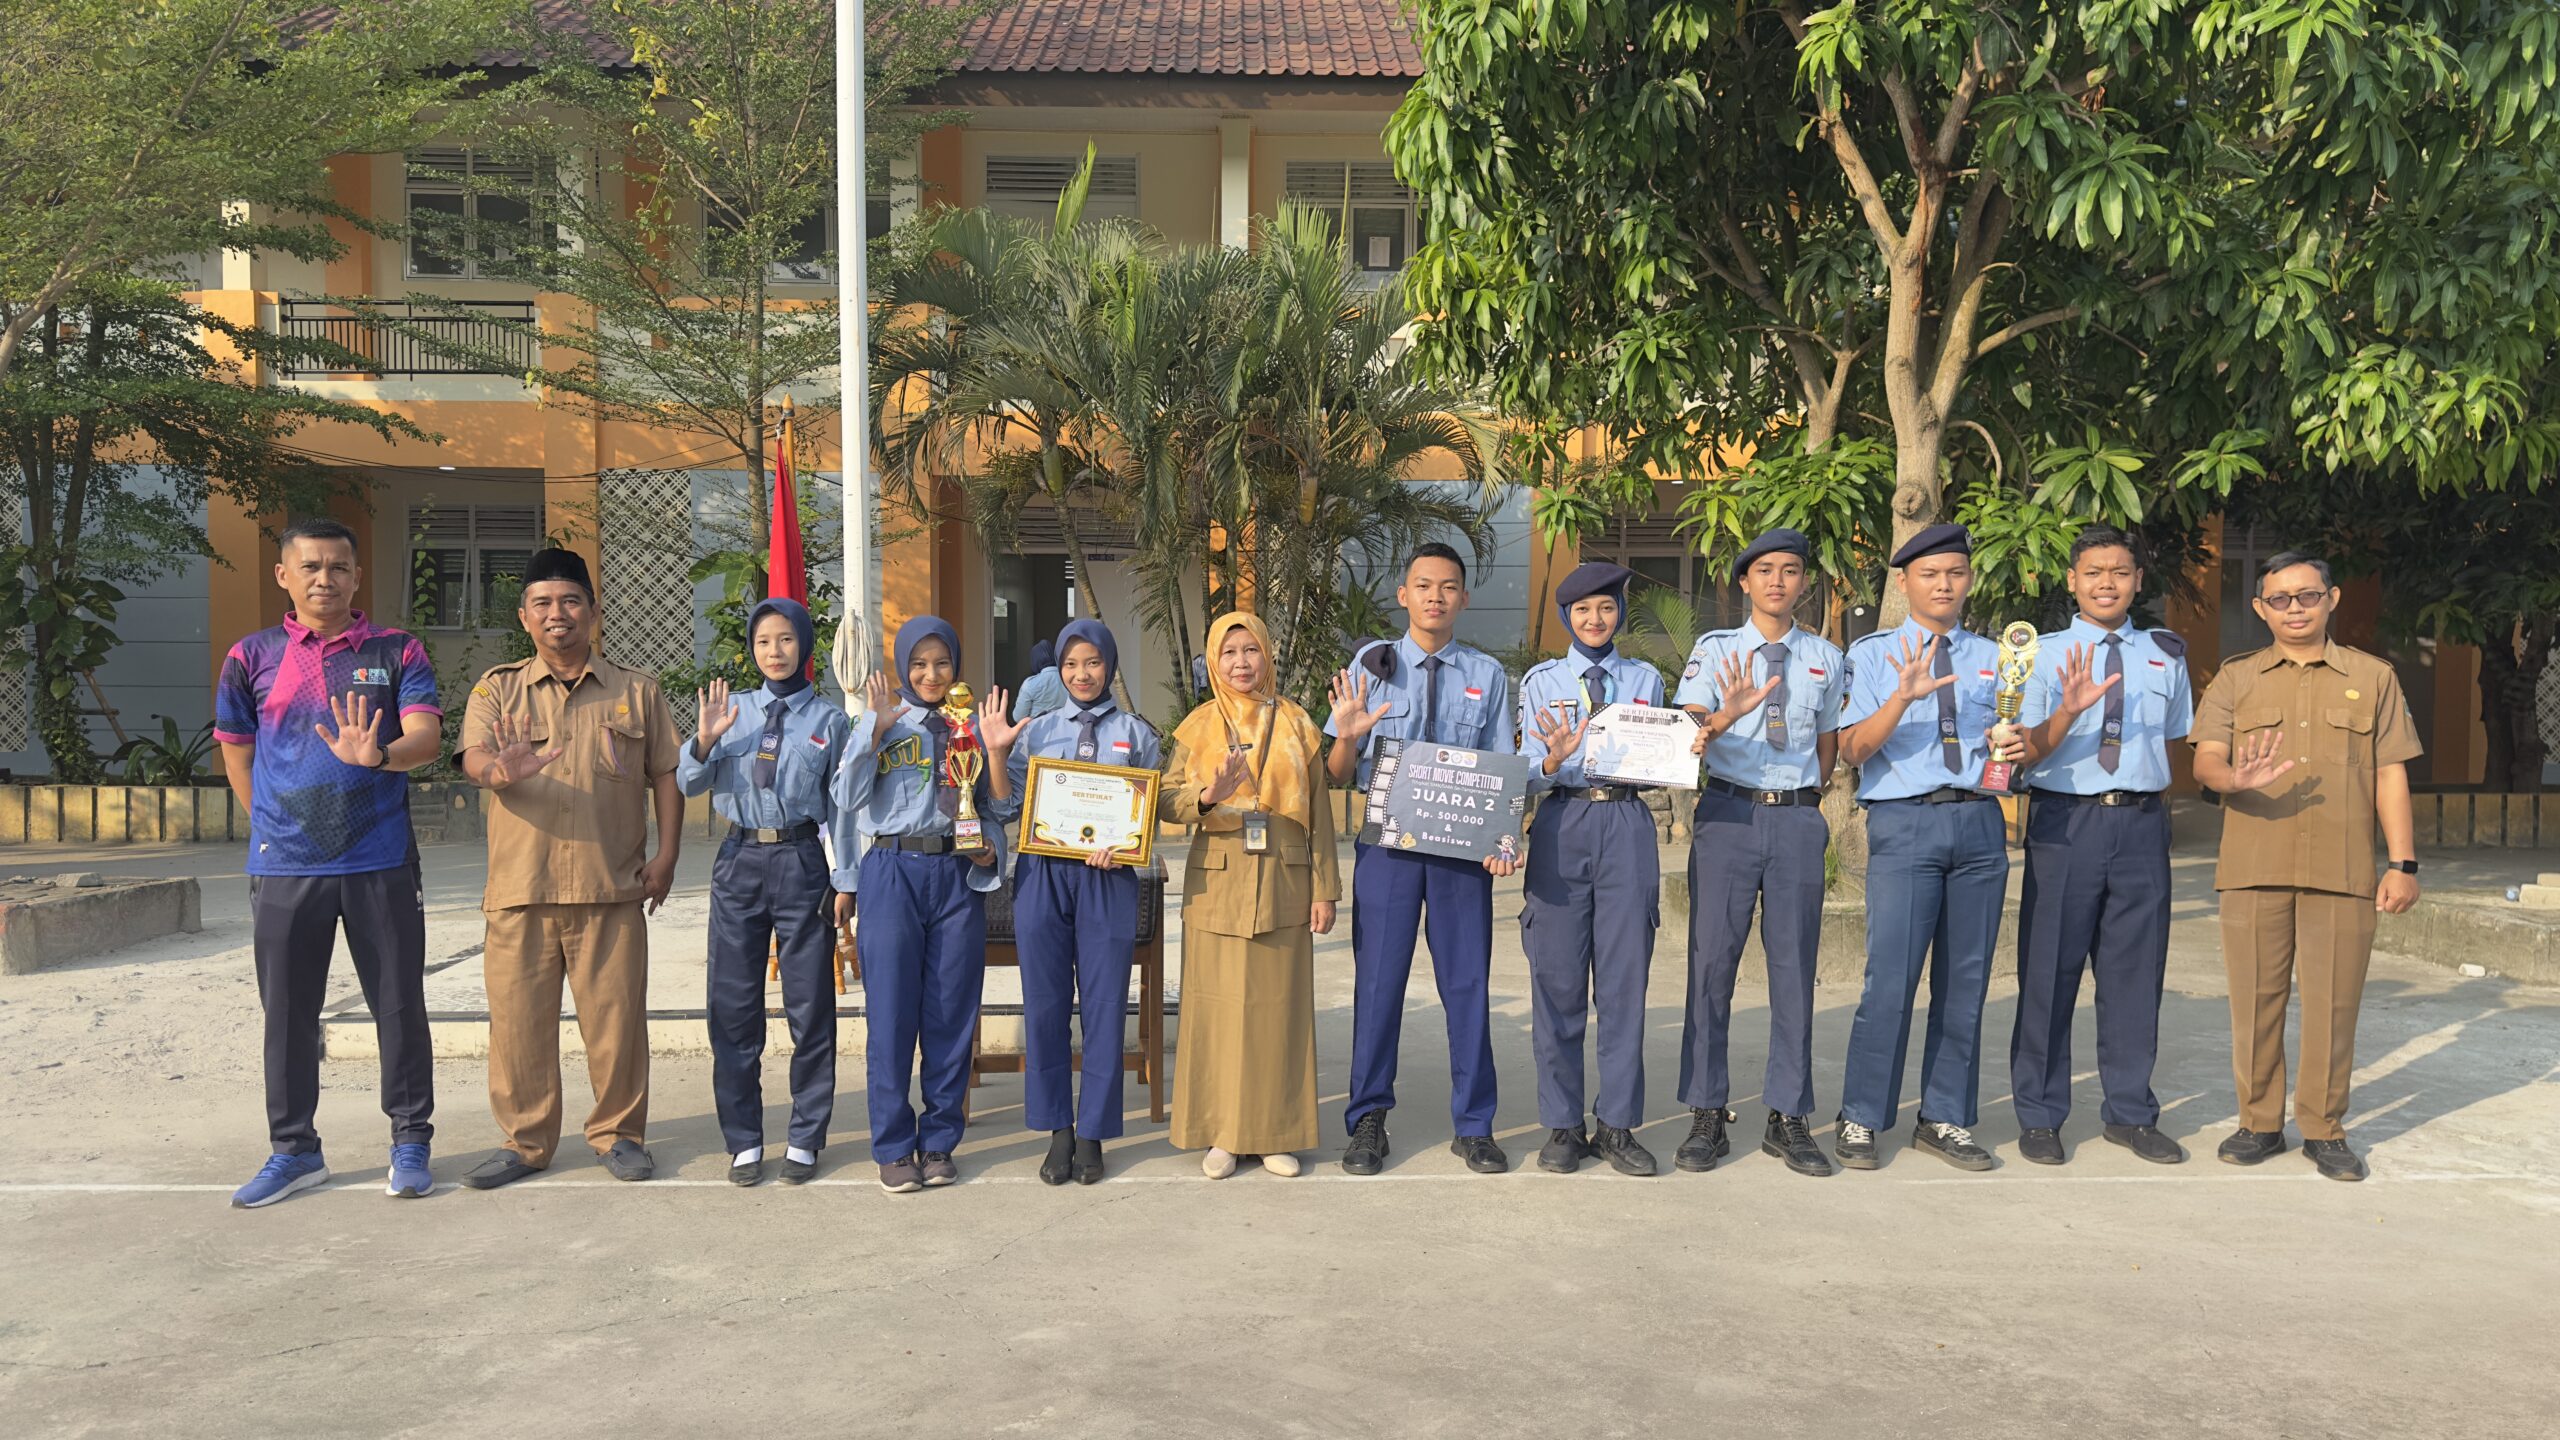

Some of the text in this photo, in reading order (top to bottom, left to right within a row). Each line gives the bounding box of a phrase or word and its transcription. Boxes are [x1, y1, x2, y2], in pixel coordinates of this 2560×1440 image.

[1622, 708, 1670, 718] SERTIFIKAT
[1409, 764, 1504, 791] SHORT MOVIE COMPETITION
[1072, 791, 1113, 801] SERTIFIKAT
[1412, 788, 1495, 811] JUARA 2
[1416, 808, 1484, 826] Rp. 500.000
[1444, 824, 1452, 833] &
[1421, 832, 1472, 847] Beasiswa
